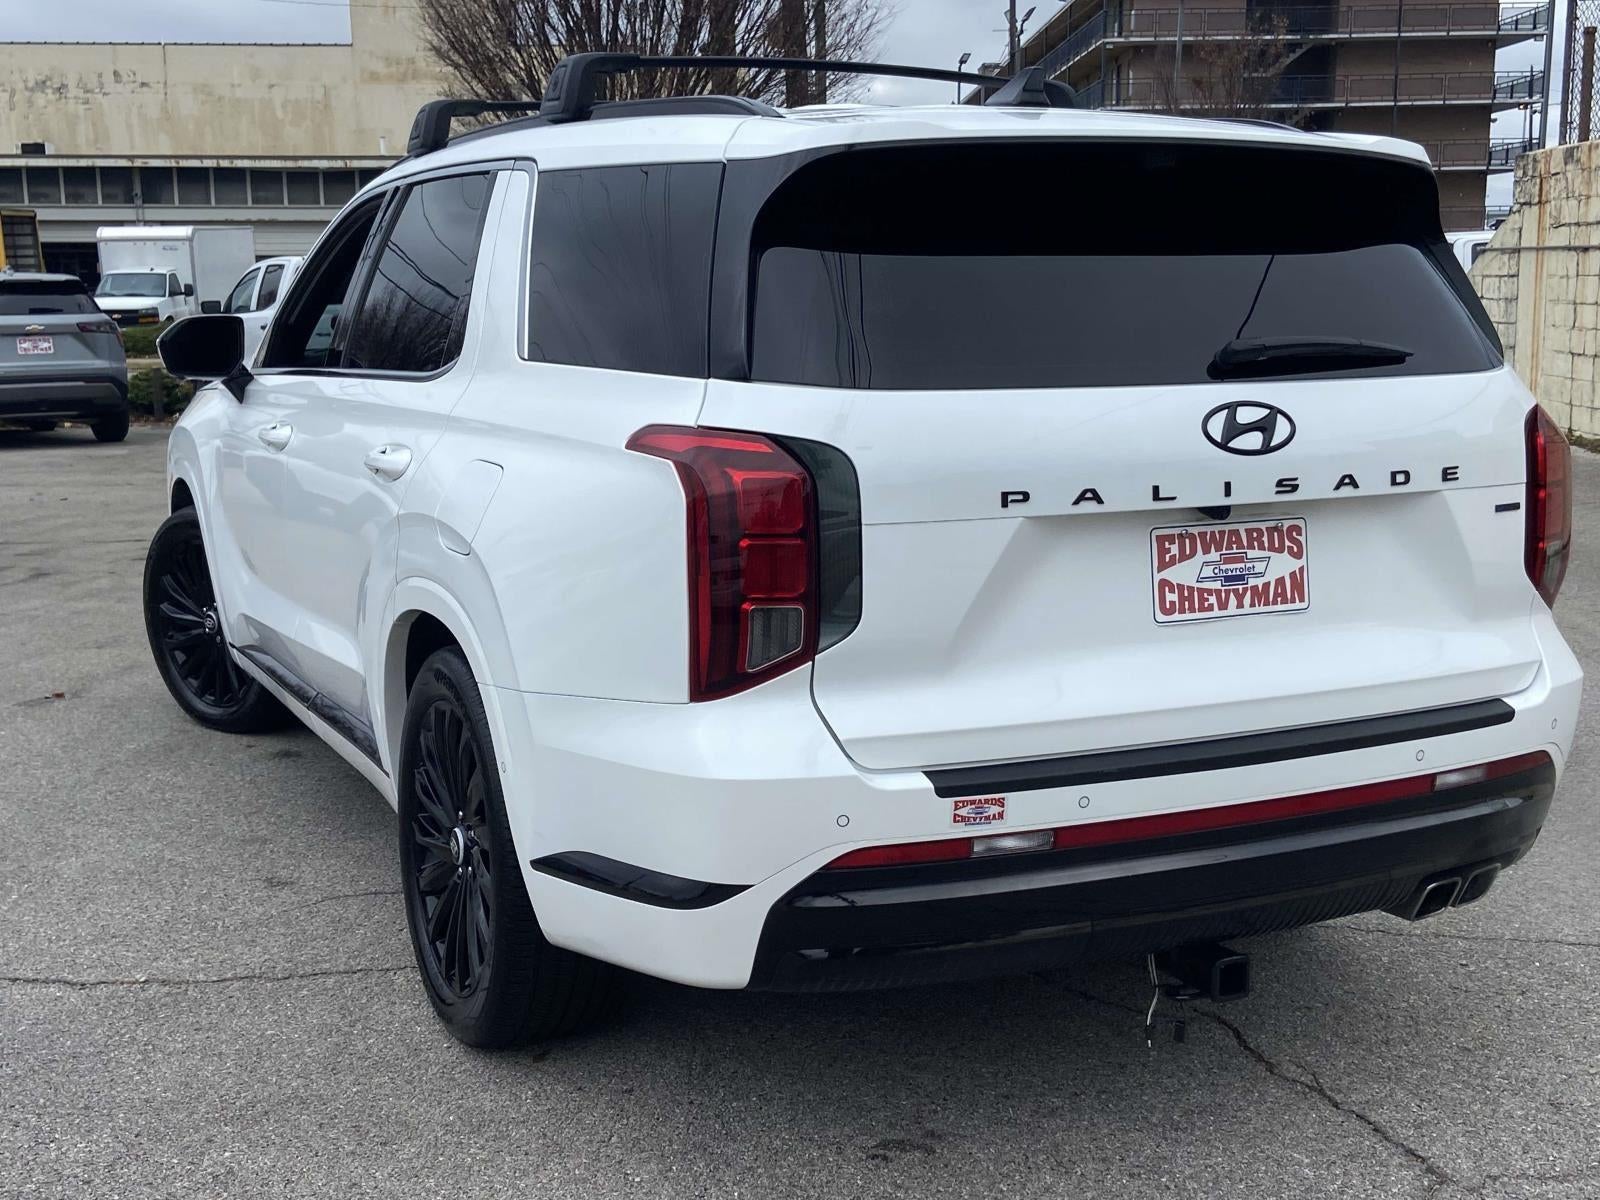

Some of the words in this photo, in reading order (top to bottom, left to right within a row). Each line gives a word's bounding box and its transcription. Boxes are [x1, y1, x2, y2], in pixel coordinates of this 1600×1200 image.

[1001, 465, 1460, 508] PALISADE
[1155, 524, 1304, 574] EDWARDS
[1212, 563, 1256, 576] Chevrolet
[1157, 565, 1306, 617] CHEVYMAN
[953, 797, 1005, 811] EDWARDS
